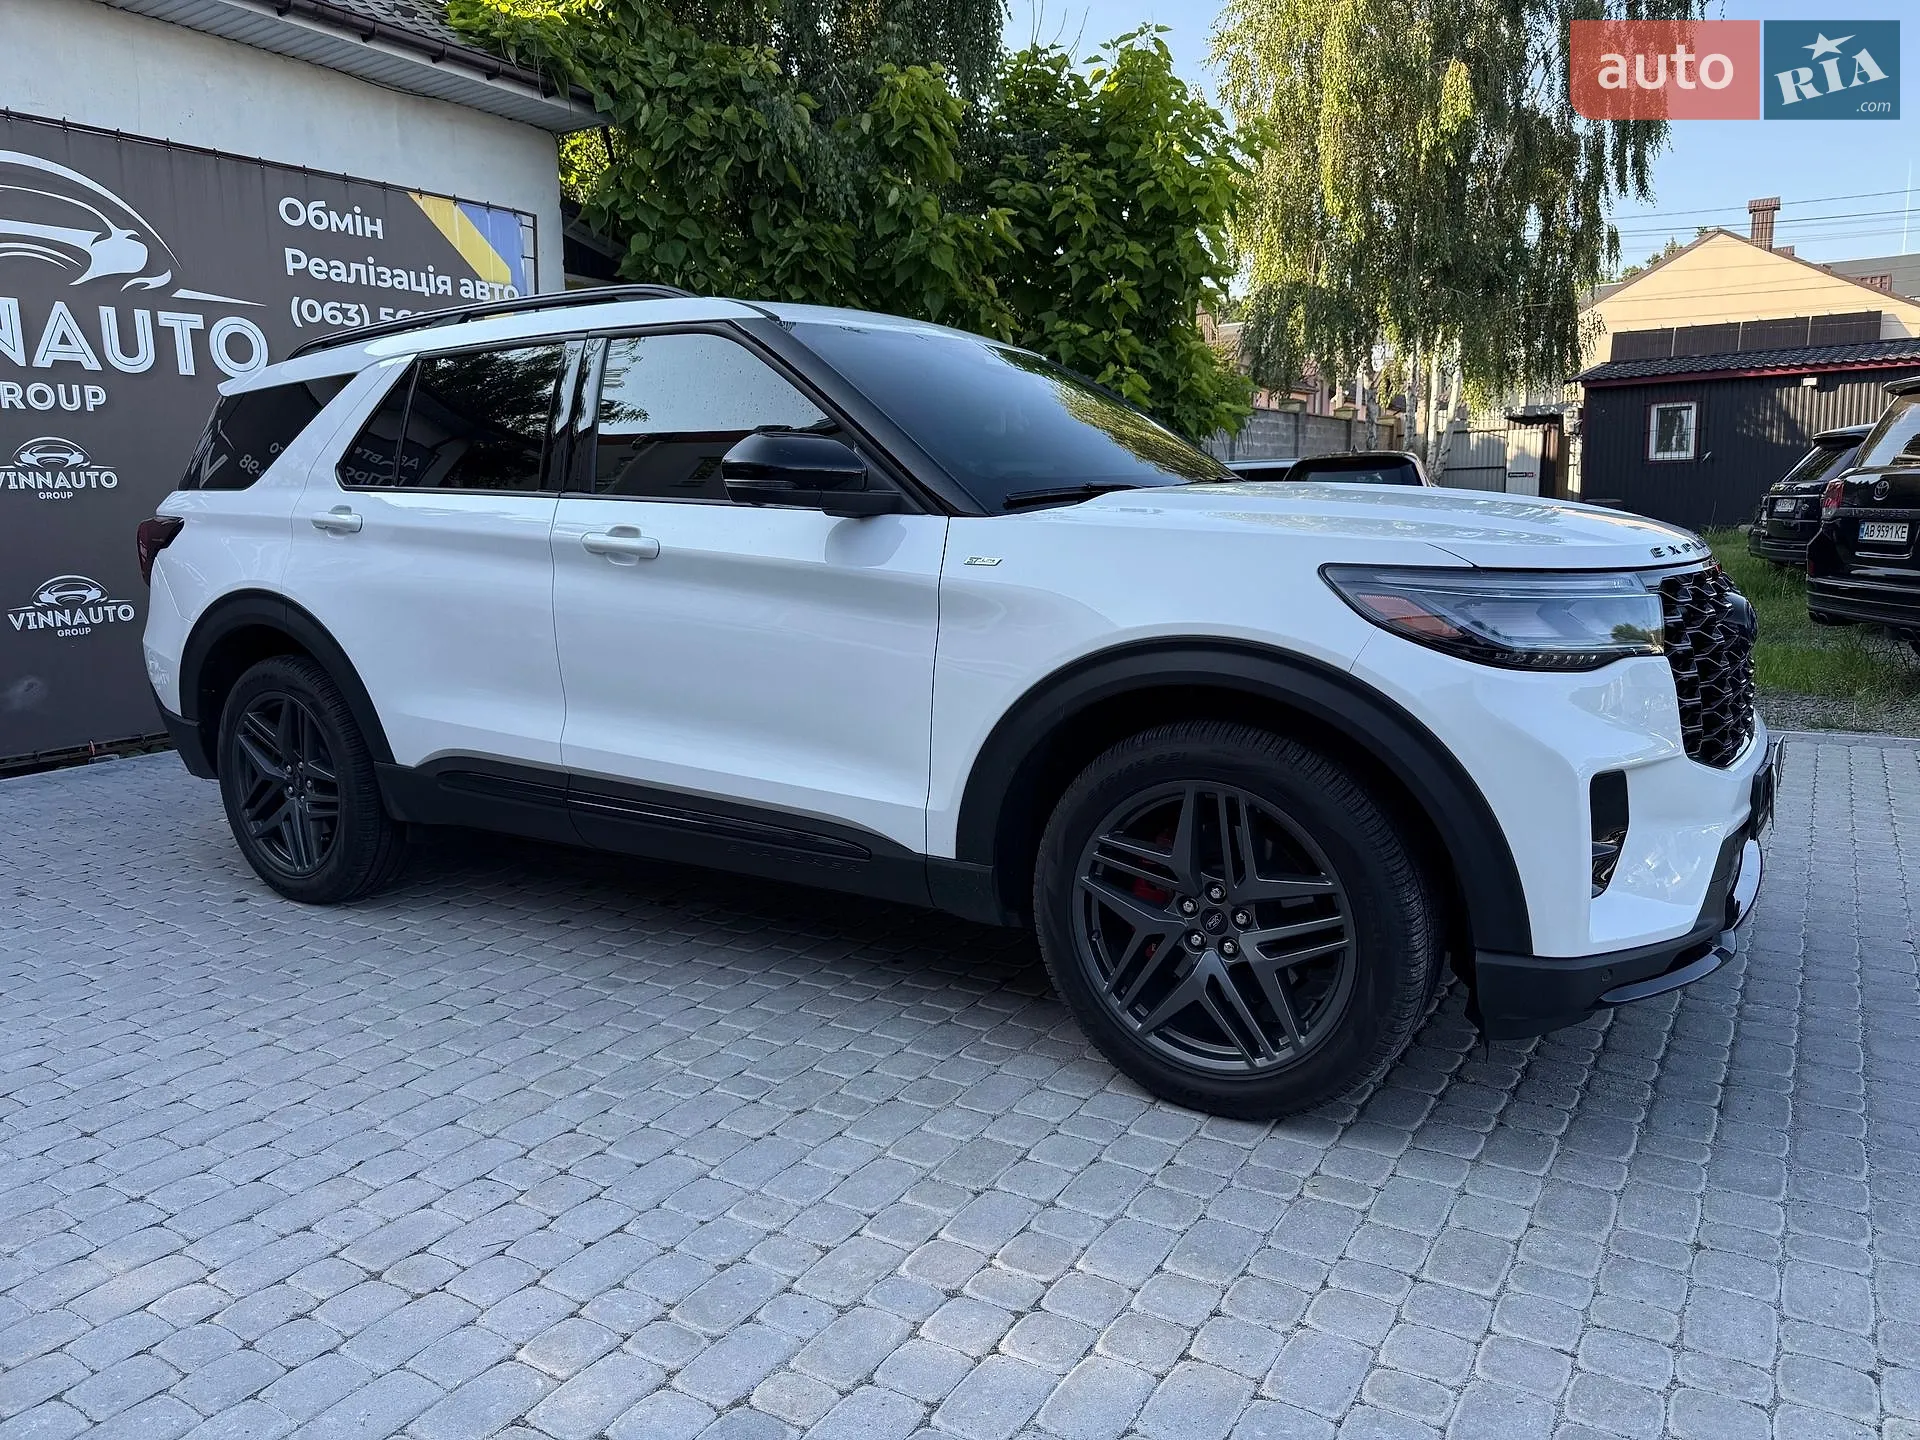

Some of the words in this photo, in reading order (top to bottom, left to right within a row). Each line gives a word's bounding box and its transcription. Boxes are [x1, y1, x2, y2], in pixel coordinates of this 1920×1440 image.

[278, 197, 384, 240] Обмін
[284, 248, 453, 297] Реалізація
[459, 277, 520, 302] авто
[291, 296, 371, 328] (063)
[0, 381, 107, 411] ROUP
[38, 491, 74, 500] GROUP
[1864, 524, 1876, 538] AB
[1877, 525, 1894, 538] 9591
[1895, 525, 1908, 539] KE
[8, 604, 135, 631] VINNAUTO
[57, 627, 91, 637] GROUP
